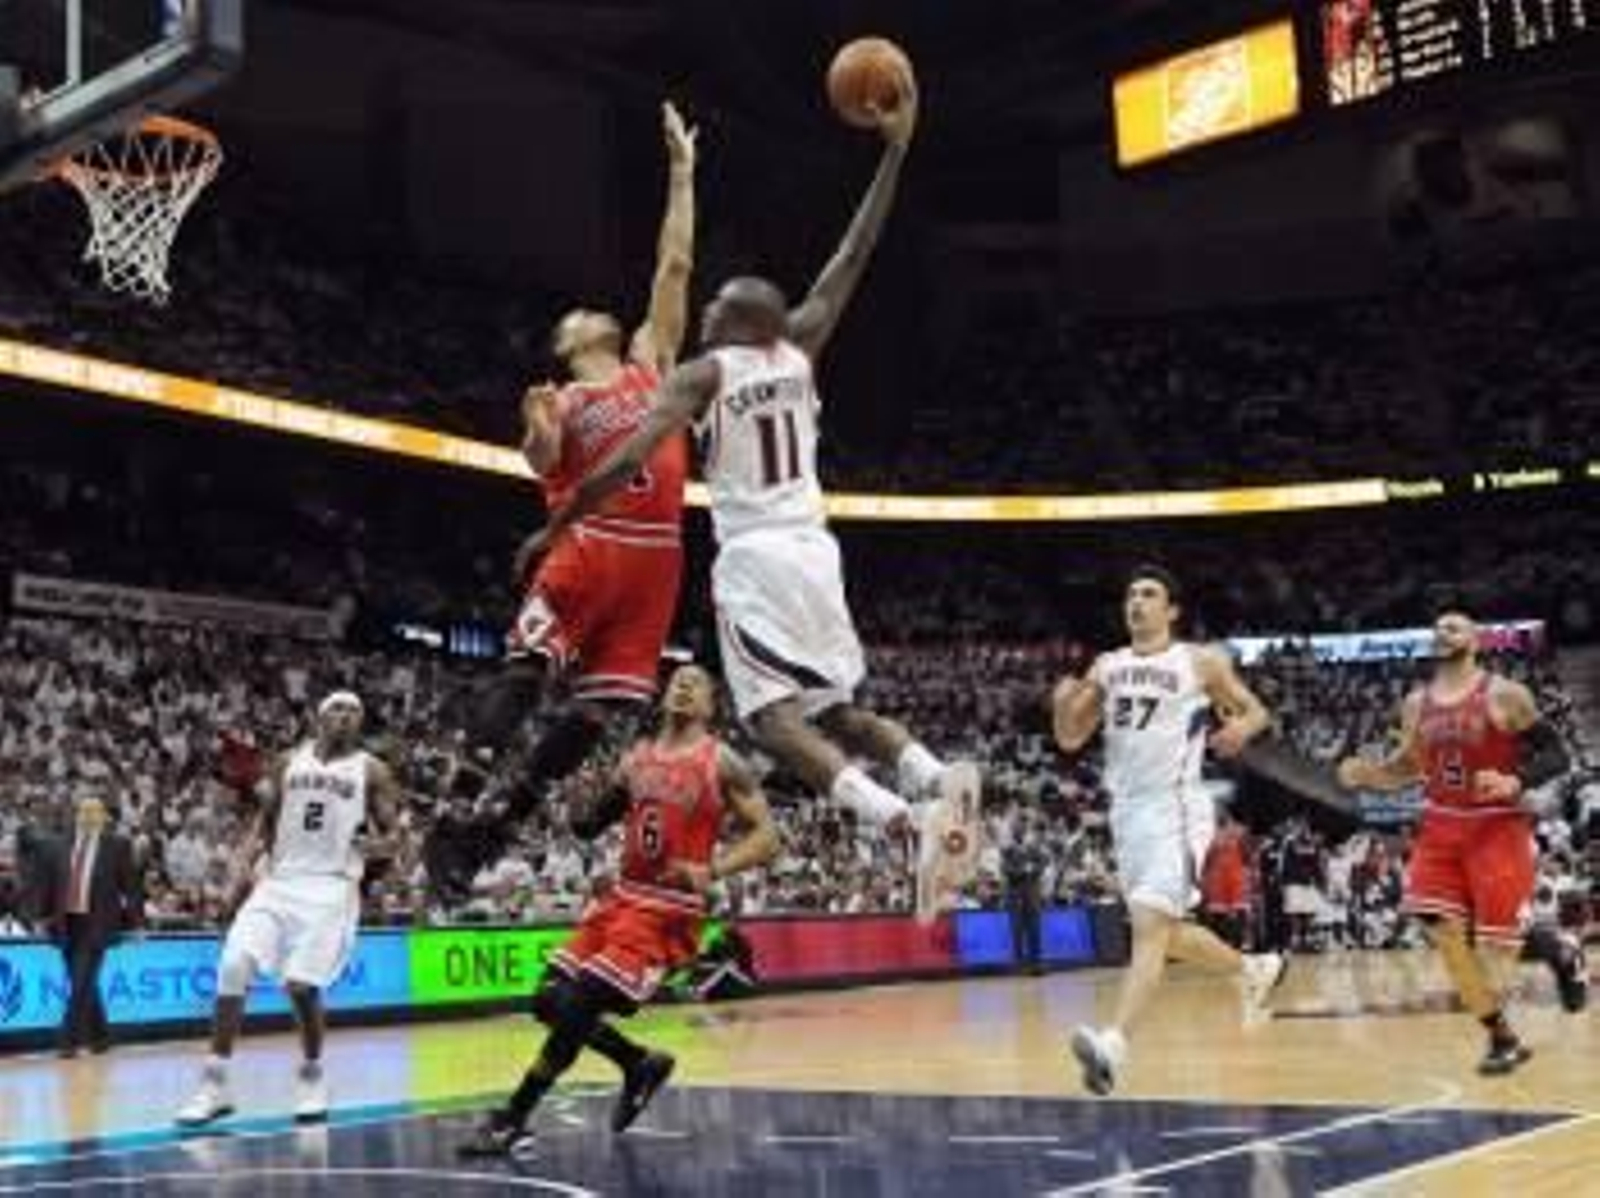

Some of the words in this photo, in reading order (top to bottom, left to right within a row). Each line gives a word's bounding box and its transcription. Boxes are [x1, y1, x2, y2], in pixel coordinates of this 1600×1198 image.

[755, 408, 803, 487] 11
[1114, 696, 1160, 731] 27
[303, 801, 324, 832] 2
[445, 943, 524, 987] ONE
